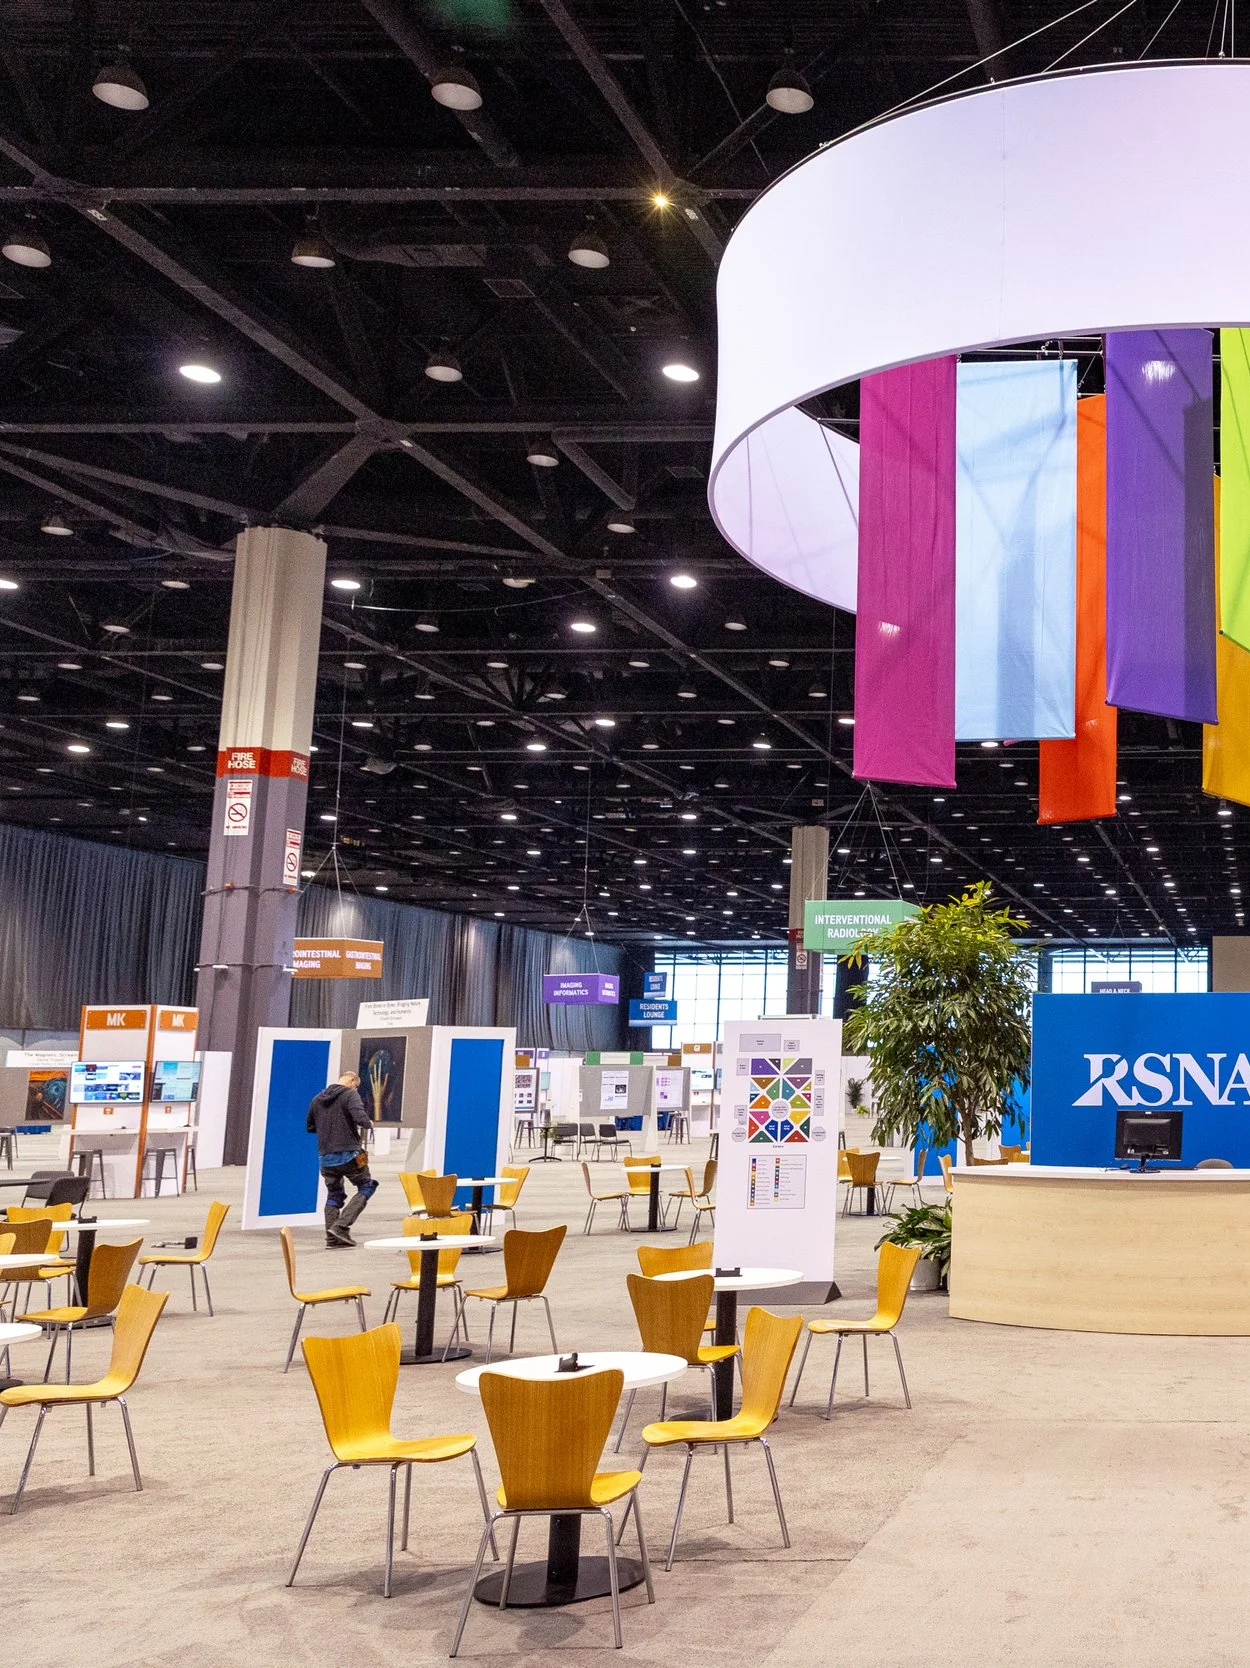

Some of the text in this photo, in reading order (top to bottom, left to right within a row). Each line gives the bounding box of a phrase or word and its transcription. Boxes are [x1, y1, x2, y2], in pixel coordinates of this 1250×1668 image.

[232, 752, 254, 760] FIRE
[227, 760, 256, 769] HOSE
[294, 757, 306, 766] FIRE
[290, 765, 307, 776] HOSE
[815, 915, 892, 925] INTERVENTIONAL
[292, 950, 341, 958] OINTESTINAL
[106, 1013, 126, 1026] MK
[172, 1014, 185, 1027] MK
